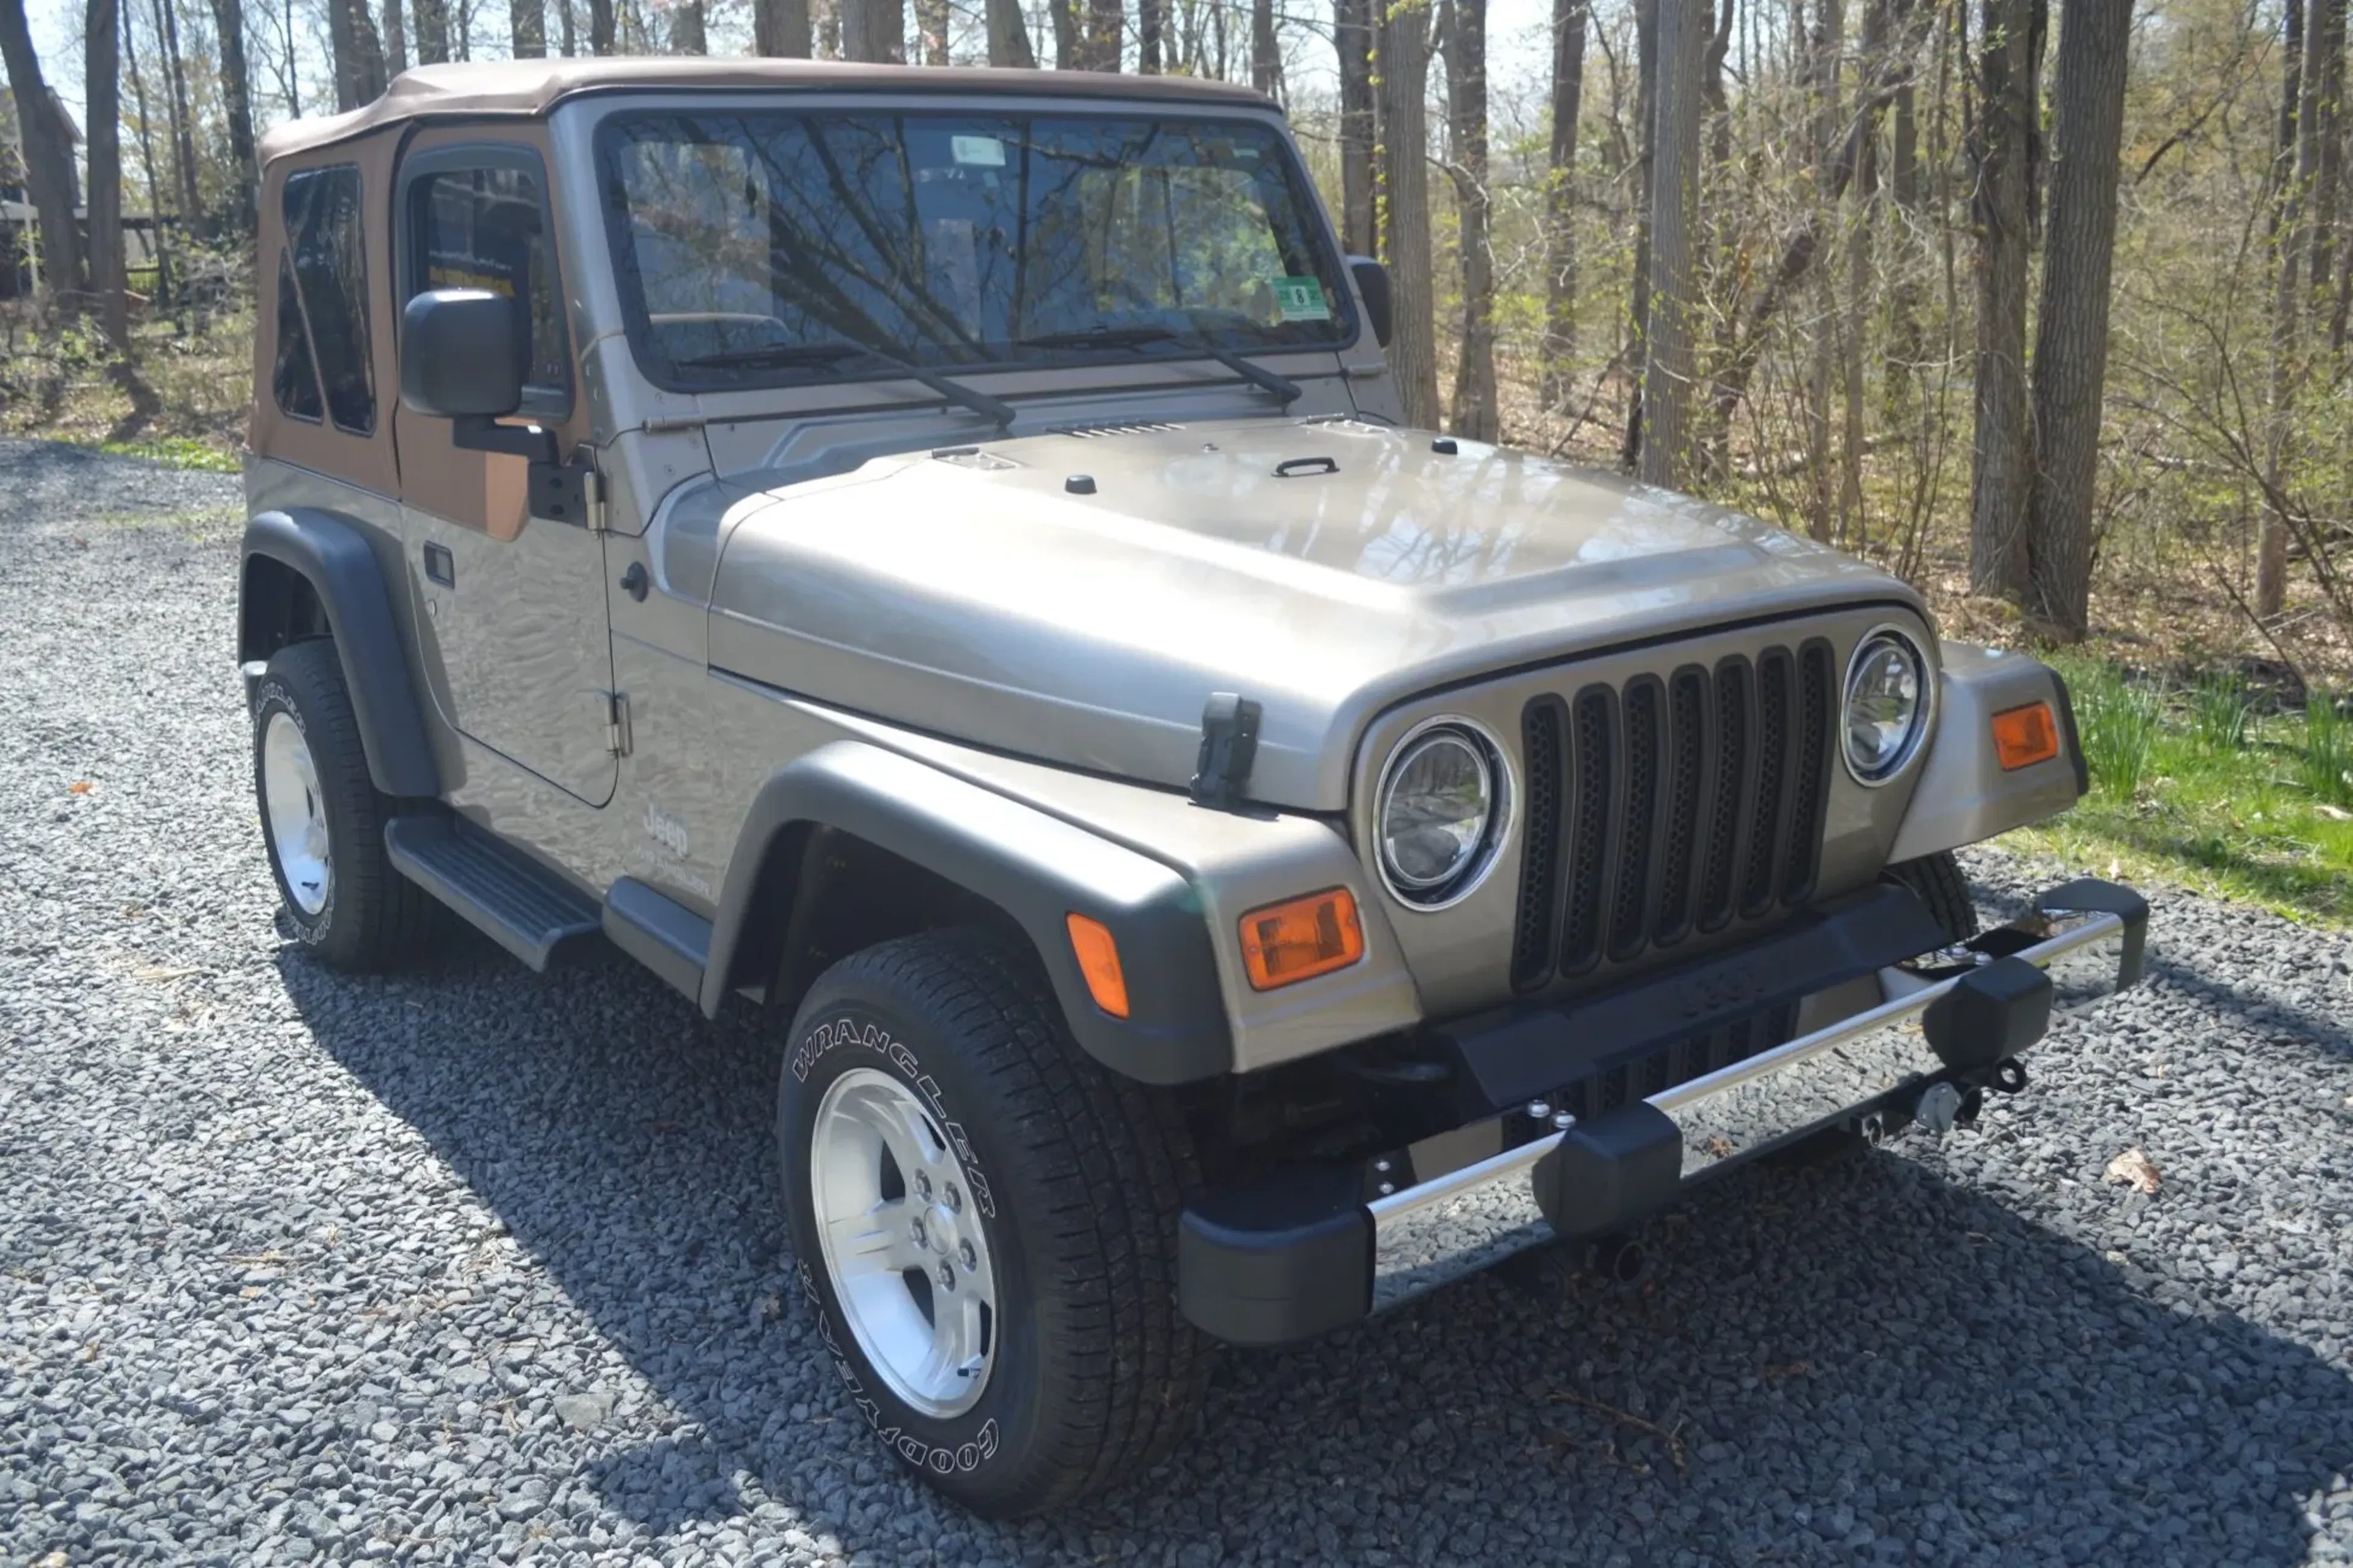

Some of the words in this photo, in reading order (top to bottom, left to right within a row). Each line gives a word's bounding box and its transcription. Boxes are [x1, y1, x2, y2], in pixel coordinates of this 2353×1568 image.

[643, 803, 688, 857] Jeep
[792, 1019, 996, 1219] WRANGLER
[798, 1258, 999, 1474] GOODYEAR
